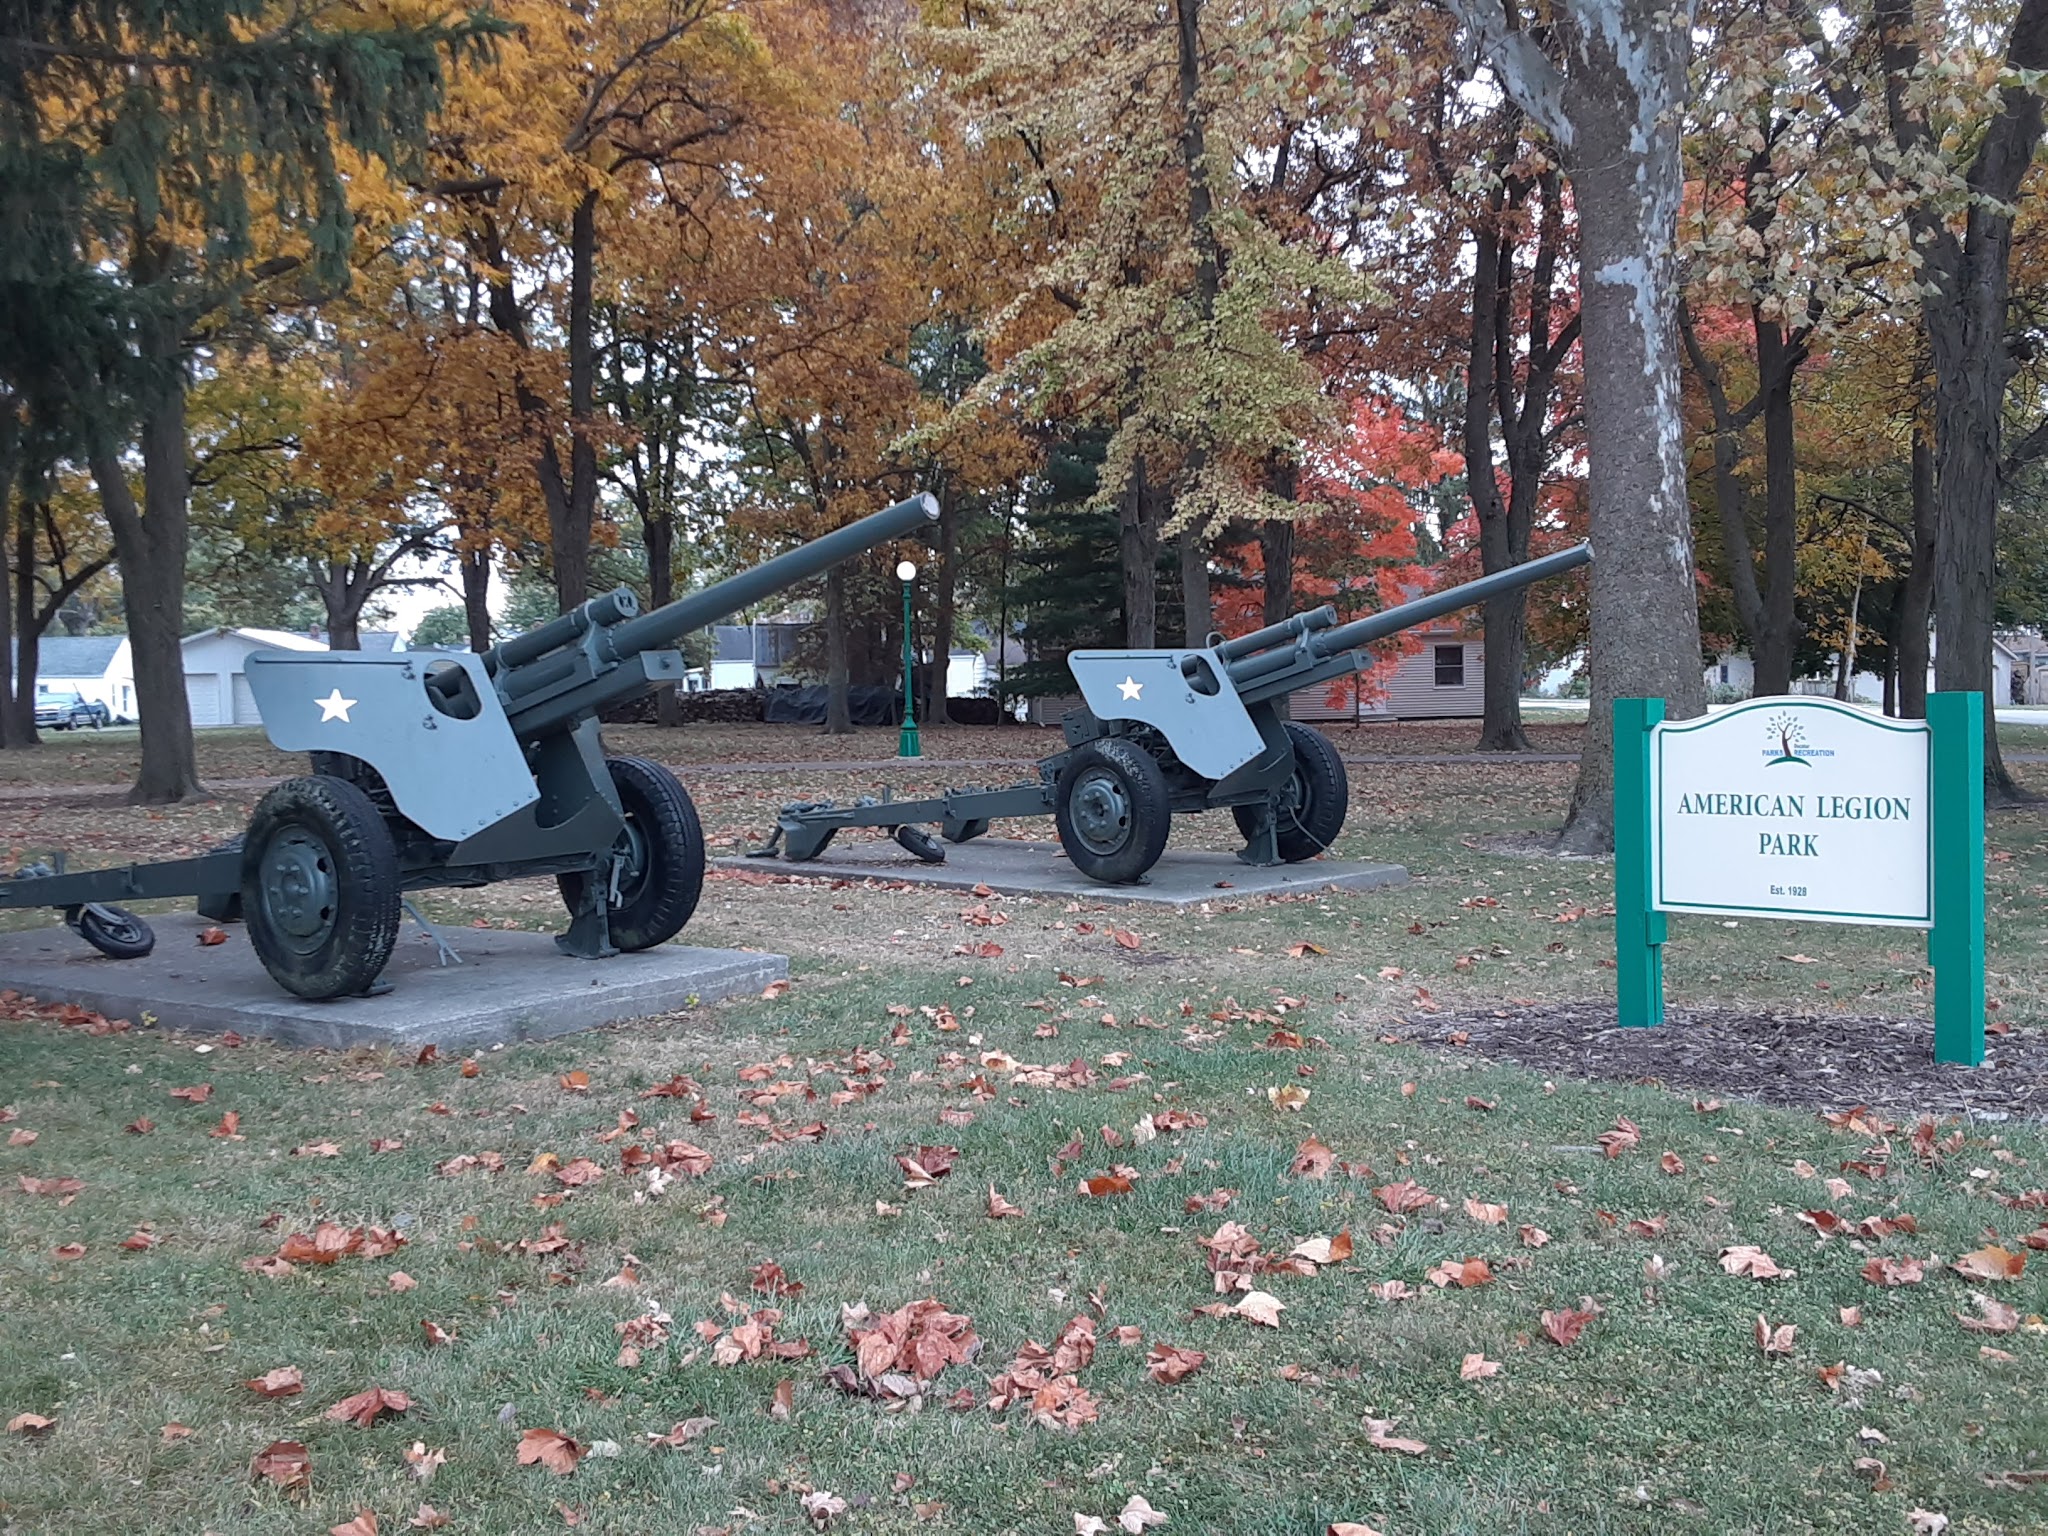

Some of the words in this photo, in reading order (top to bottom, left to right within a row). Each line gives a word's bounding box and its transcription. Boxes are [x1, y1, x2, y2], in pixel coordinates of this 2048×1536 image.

[1761, 749, 1783, 757] PARKS
[1794, 749, 1835, 757] RECREATION
[1677, 792, 1804, 817] AMERICAN
[1816, 795, 1911, 820] LEGION
[1759, 833, 1819, 857] PARK
[1770, 884, 1785, 895] Est.
[1788, 886, 1807, 897] 1928
